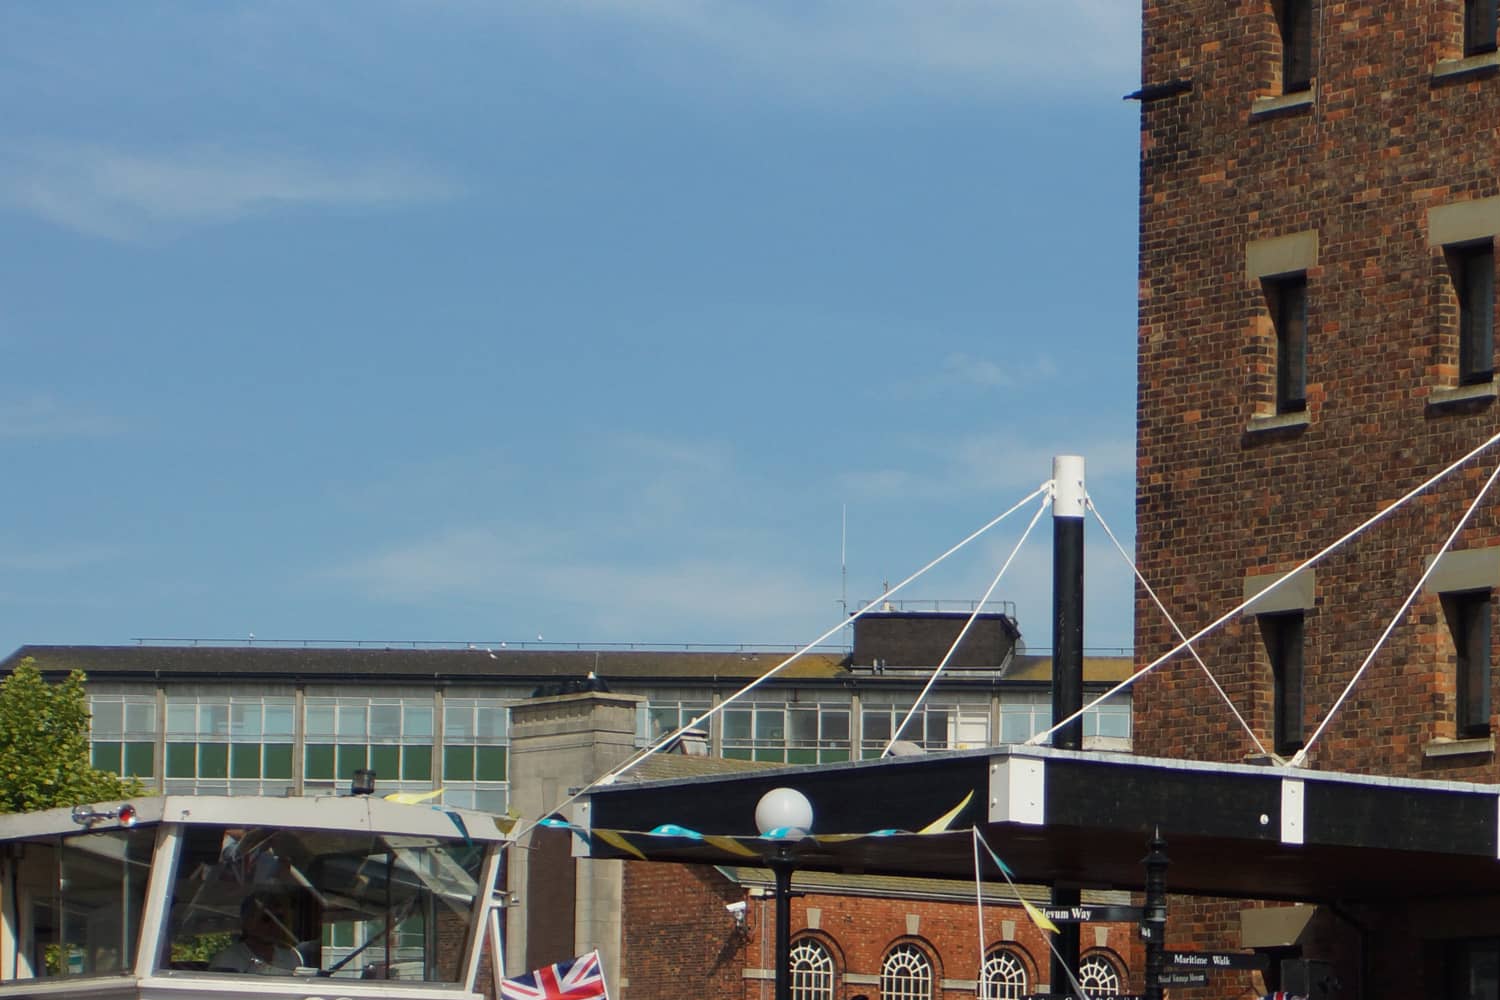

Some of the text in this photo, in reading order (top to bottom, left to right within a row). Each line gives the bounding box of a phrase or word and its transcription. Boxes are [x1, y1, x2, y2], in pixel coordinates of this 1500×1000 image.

[1037, 907, 1091, 921] levum Way
[1173, 954, 1231, 966] Maritime Walk
